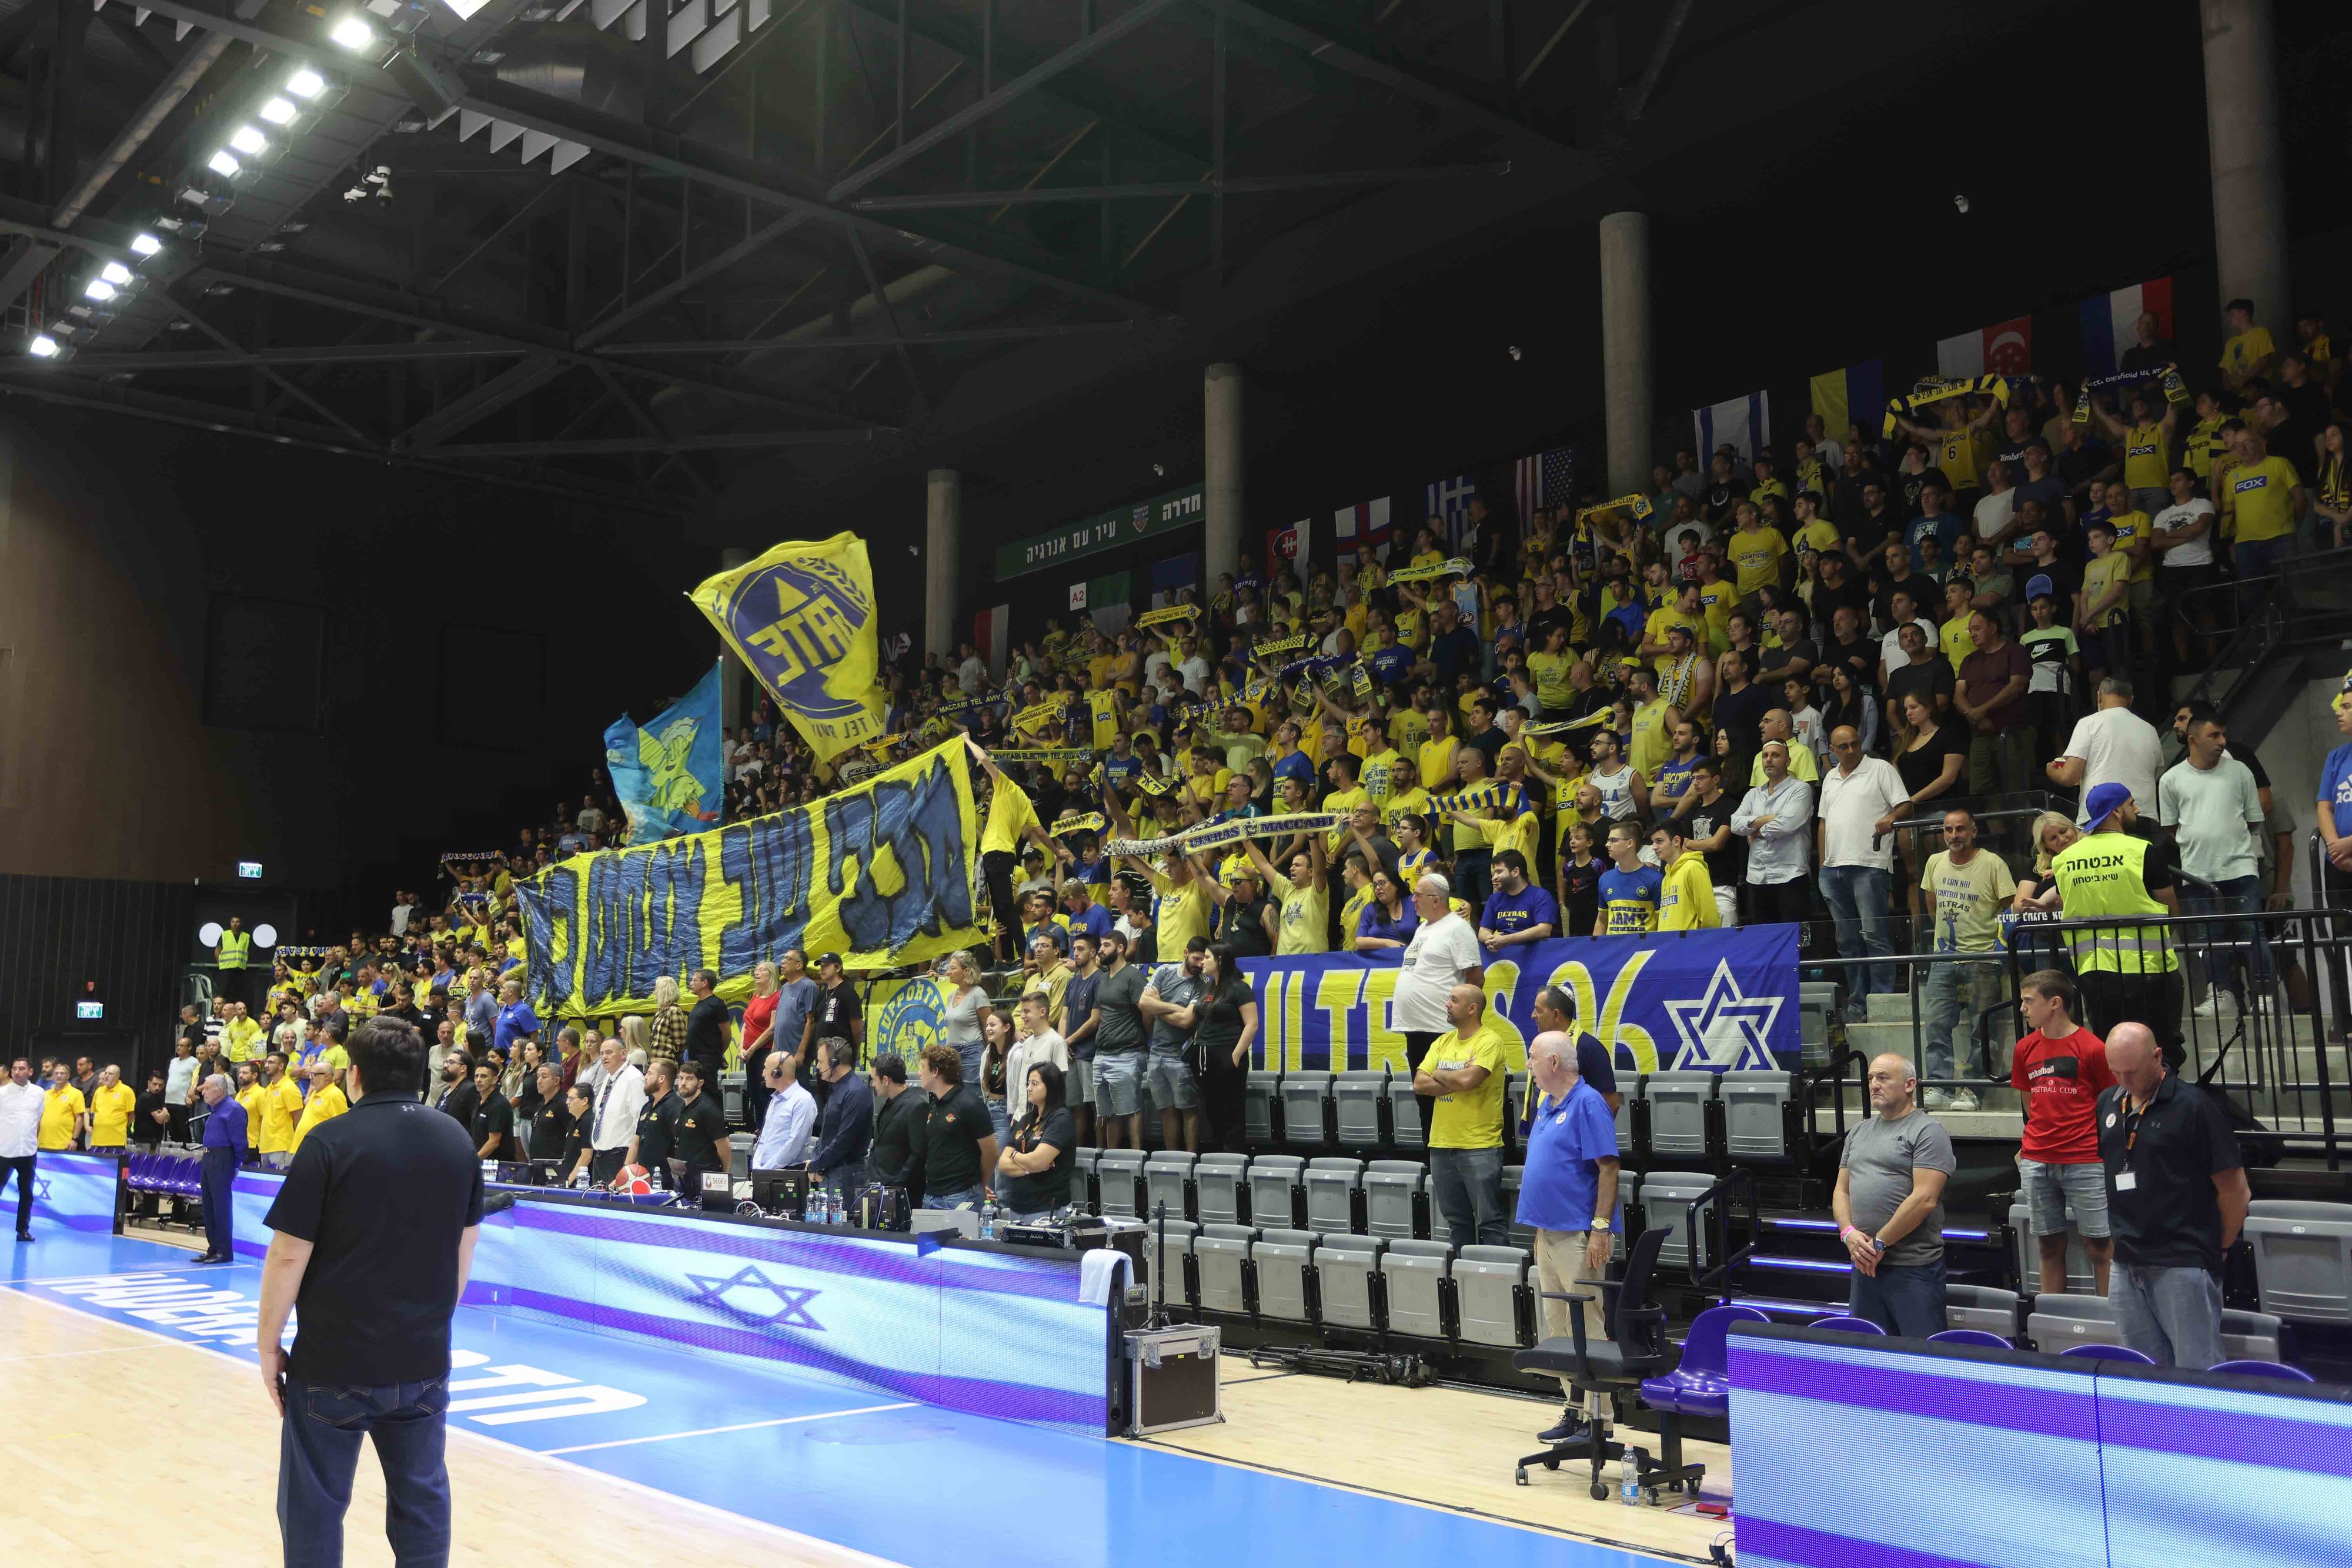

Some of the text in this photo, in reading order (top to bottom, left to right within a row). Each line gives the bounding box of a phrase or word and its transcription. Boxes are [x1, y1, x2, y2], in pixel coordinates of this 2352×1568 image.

[1948, 446, 1957, 461] 6
[2129, 445, 2155, 458] FOX
[2236, 477, 2264, 492] FOX
[1162, 493, 1201, 521] חדרה
[2117, 526, 2132, 537] OX
[1027, 520, 1116, 563] עיר עם אנרגיה
[1072, 590, 1084, 603] A2
[1700, 595, 1716, 604] OX
[1953, 633, 1959, 643] 6
[2034, 643, 2052, 653] NIKE
[1375, 657, 1395, 666] MACCABI
[939, 694, 1001, 713] MACCABI TEL AVIV
[1015, 706, 1055, 726] BASKETBALL CLUB
[1663, 771, 1692, 784] MACCAB
[1558, 801, 1573, 810] FOX
[1189, 825, 1241, 848] ULTRAS
[1260, 815, 1335, 833] MACCABI
[2066, 854, 2124, 872] אבטחה
[241, 865, 261, 877] יציאה
[1947, 878, 1959, 888] CON
[1960, 880, 1971, 889] NOI
[2072, 872, 2119, 887] שיא ביטחון
[1938, 890, 1979, 902] CONTRO DI NOI
[1938, 900, 1971, 912] ULTRAS
[1497, 911, 1528, 919] ULTRAS
[79, 1004, 101, 1018] יציאה
[878, 984, 948, 1045] SUPPORTERS
